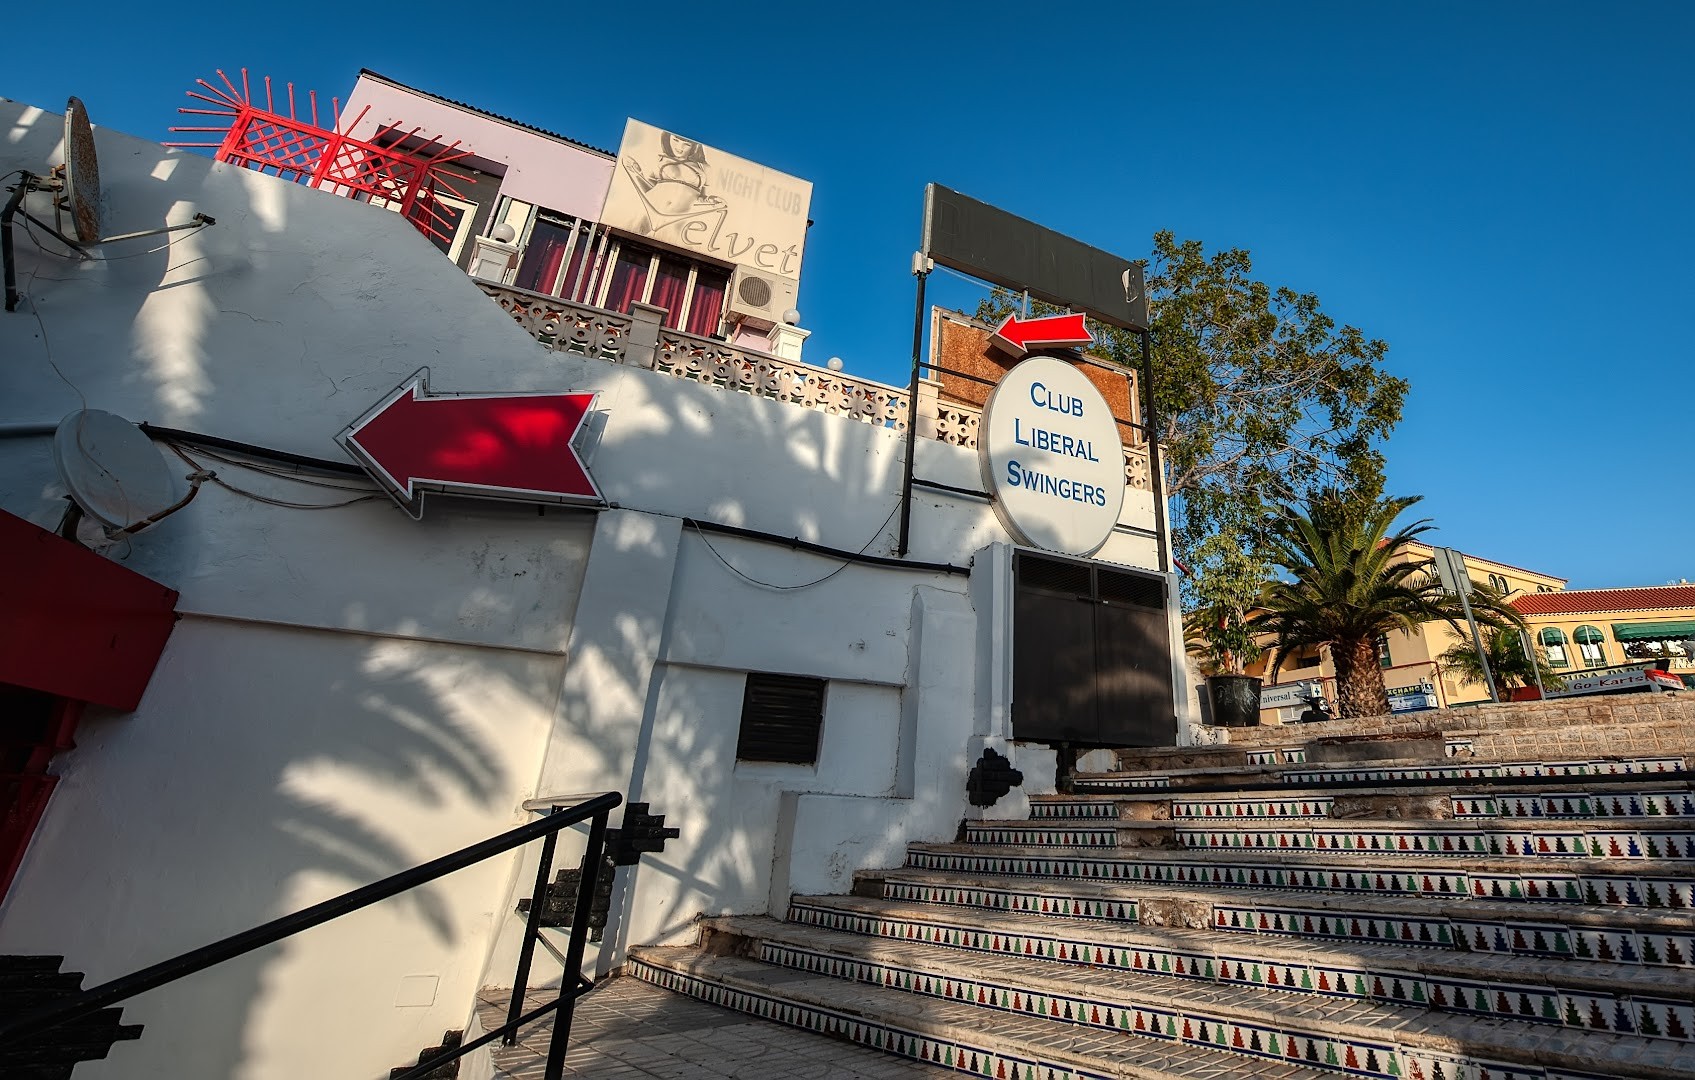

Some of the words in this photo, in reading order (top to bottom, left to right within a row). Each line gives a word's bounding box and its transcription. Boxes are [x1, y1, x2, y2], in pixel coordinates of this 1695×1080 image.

[717, 167, 762, 203] NIGHT
[766, 184, 802, 216] CLUB
[1387, 684, 1420, 696] XCHANG
[1261, 691, 1291, 704] niversal
